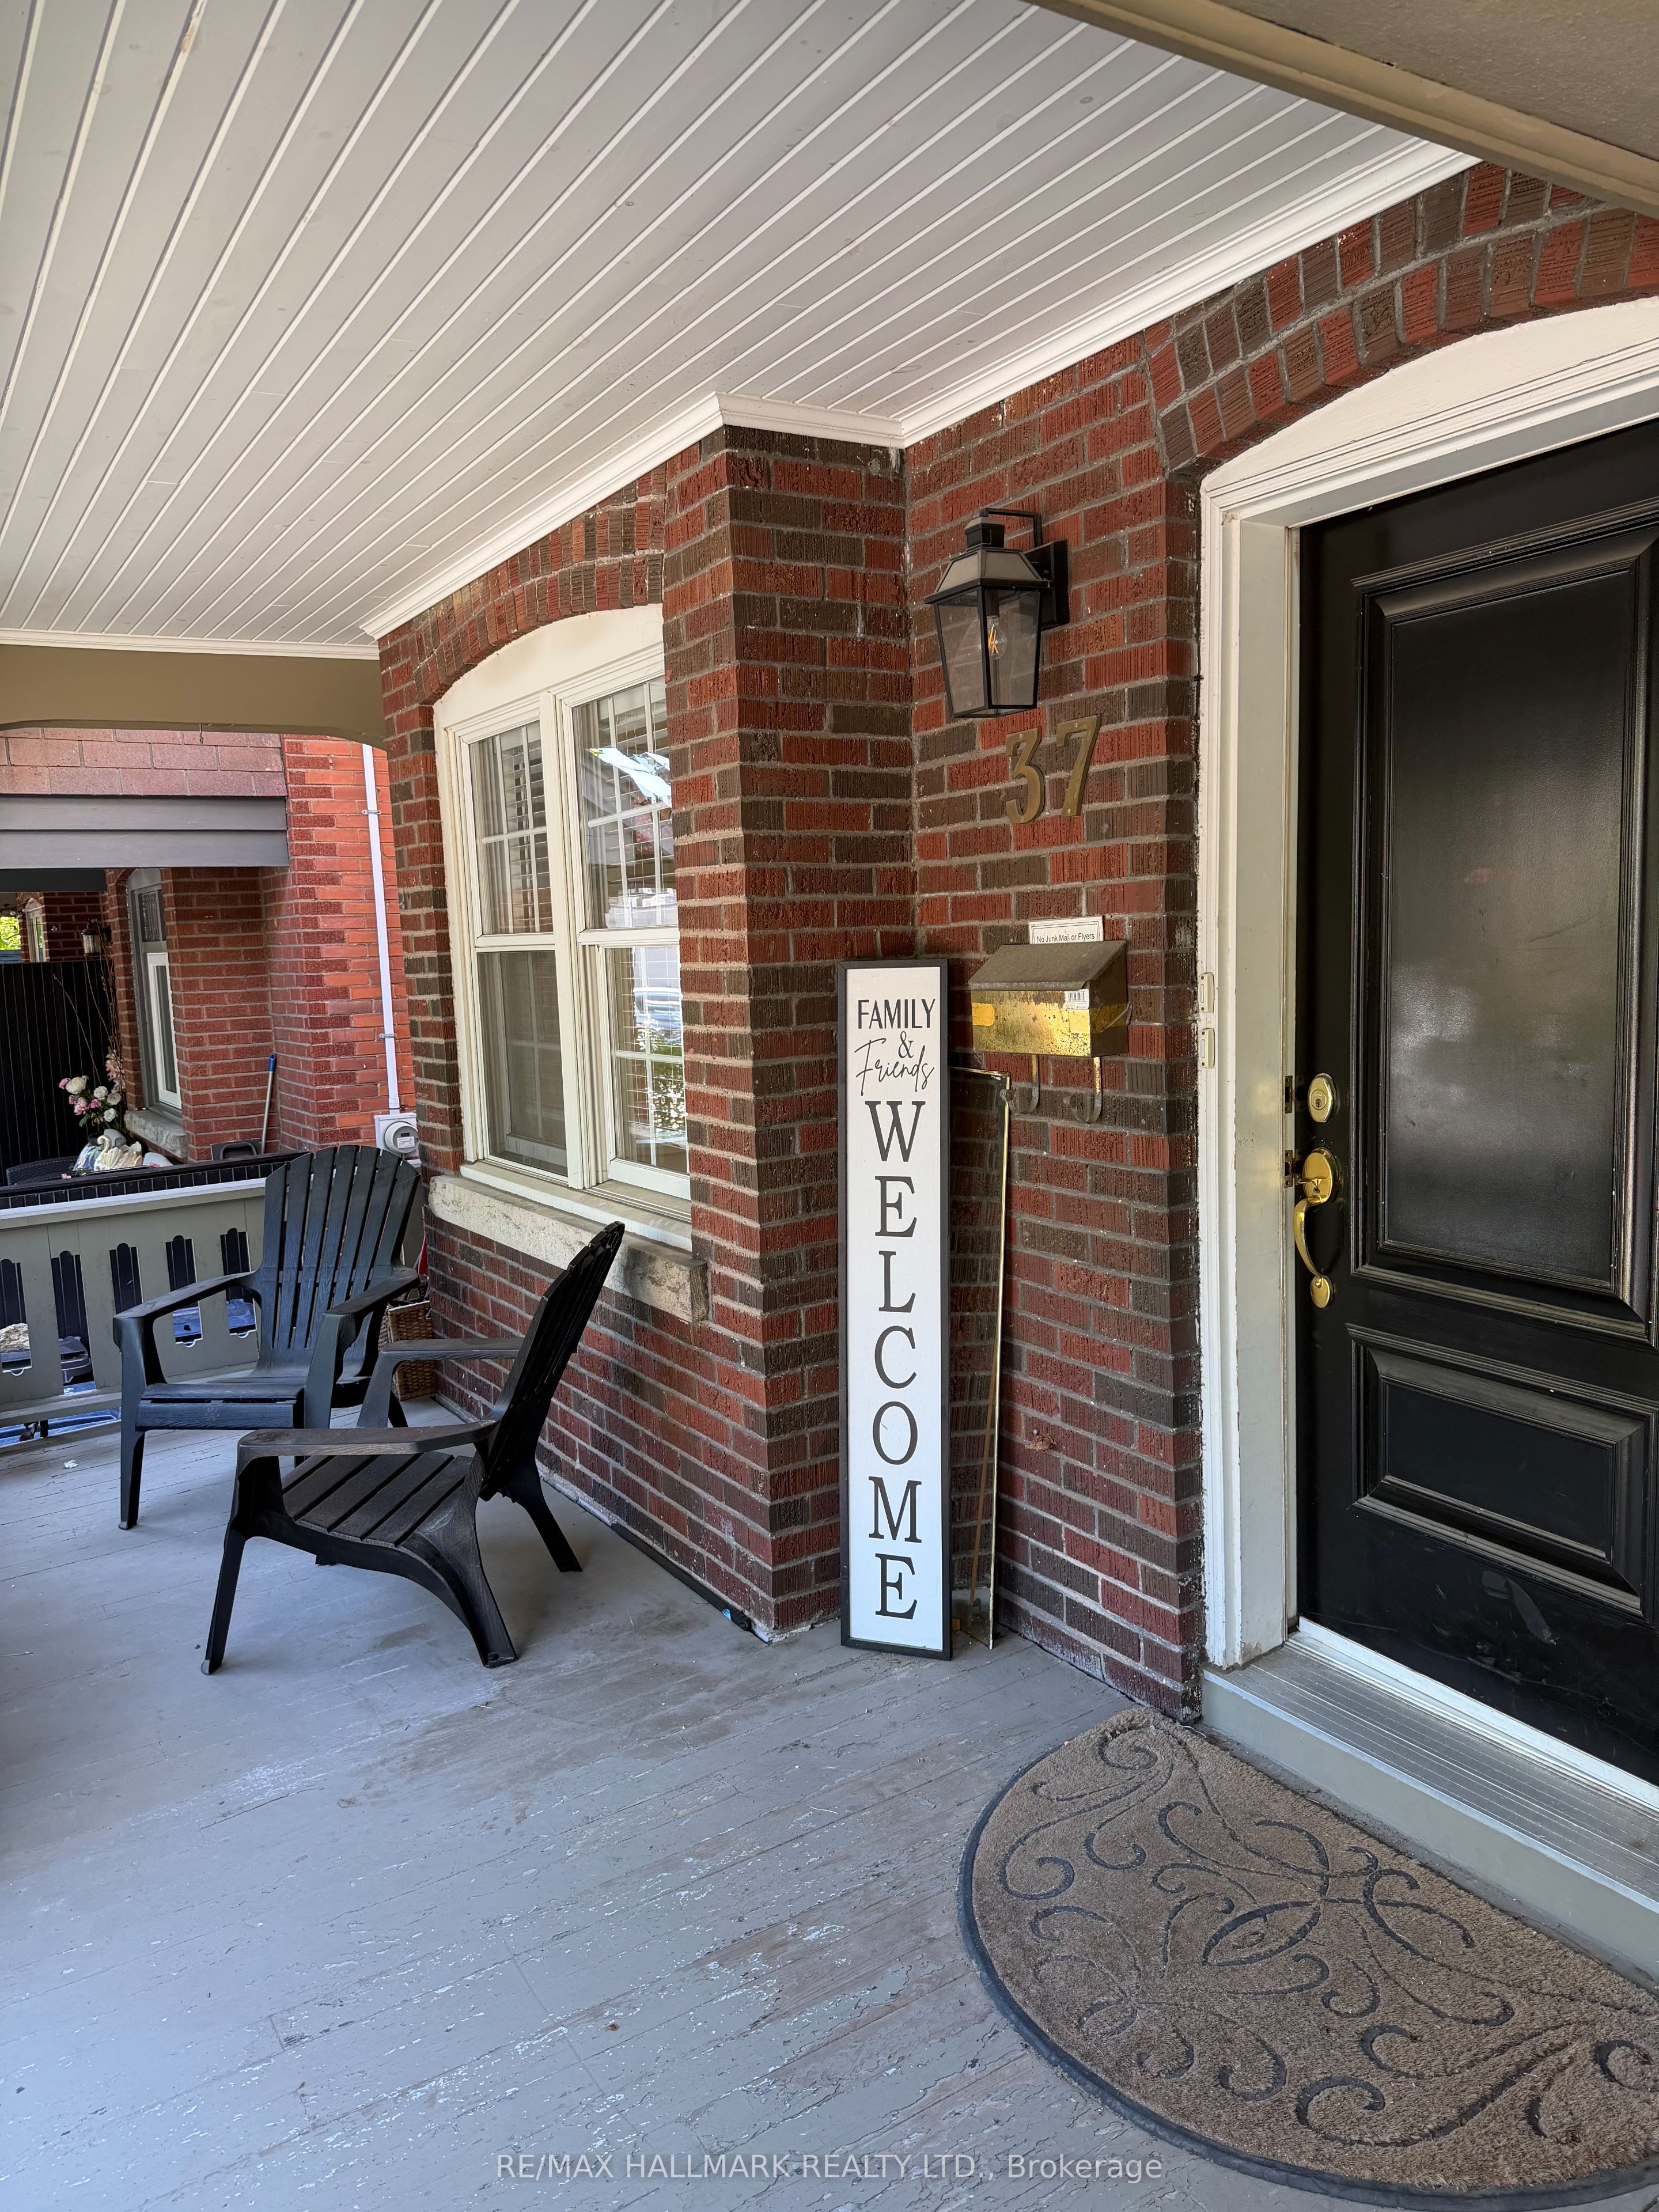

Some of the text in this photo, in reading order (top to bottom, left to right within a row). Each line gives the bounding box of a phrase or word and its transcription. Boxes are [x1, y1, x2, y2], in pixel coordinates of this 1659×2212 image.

[1006, 714, 1101, 824] 37
[1078, 933, 1094, 942] Flyers
[858, 998, 935, 1029] FAMILY
[854, 1038, 935, 1096] Friends
[898, 1031, 914, 1059] &
[865, 1101, 926, 1620] WELCOME
